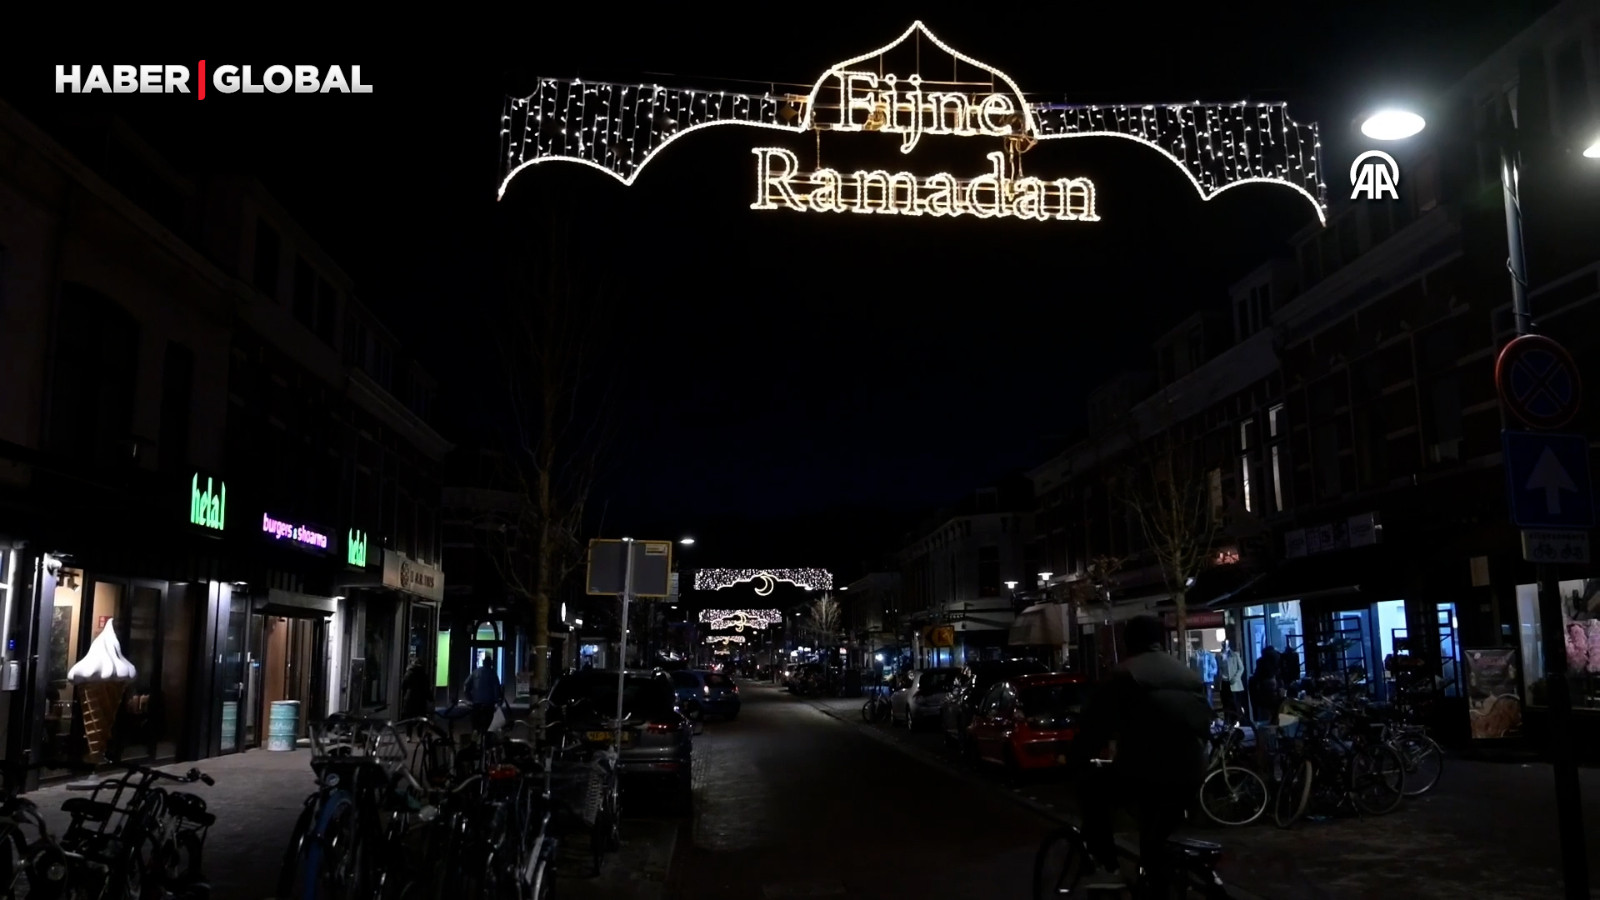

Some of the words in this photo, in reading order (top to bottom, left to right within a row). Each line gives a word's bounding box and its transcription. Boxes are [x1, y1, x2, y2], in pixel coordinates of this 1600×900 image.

[832, 70, 1015, 153] Fijne
[750, 147, 1101, 221] Ramadan
[190, 472, 226, 530] helal
[262, 512, 293, 539] burgers
[297, 525, 327, 548] shoarma
[348, 527, 367, 567] helal
